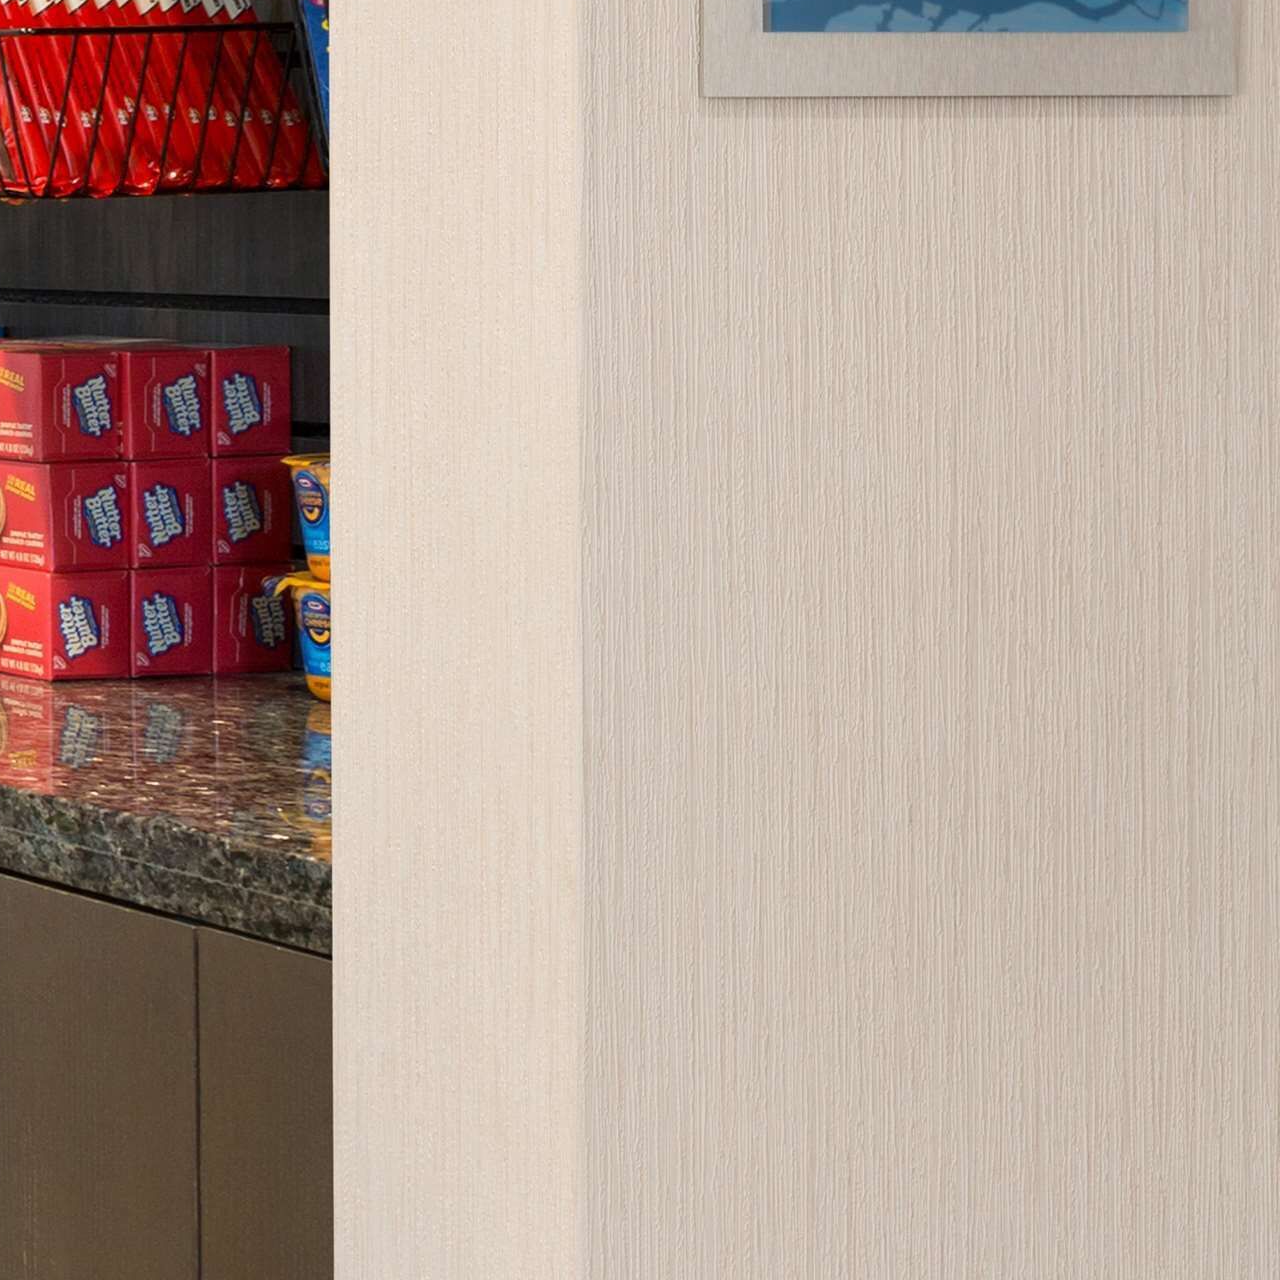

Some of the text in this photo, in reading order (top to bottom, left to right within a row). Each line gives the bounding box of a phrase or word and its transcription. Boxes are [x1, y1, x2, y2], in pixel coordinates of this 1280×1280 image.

[74, 385, 102, 436] Butter
[88, 376, 112, 429] Nutter
[164, 385, 190, 436] Butter
[177, 375, 201, 429] Nutter
[223, 380, 249, 435] Nutter
[234, 373, 261, 425] Butter
[85, 496, 112, 547] Butter
[97, 486, 122, 541] Nutter
[144, 491, 169, 547] Nutter
[155, 485, 183, 536] Butter
[223, 487, 248, 543] Nutter
[235, 481, 261, 532] Butter
[59, 603, 85, 659] Nutter
[71, 596, 99, 649] Butter
[142, 599, 168, 656] Nutter
[154, 593, 181, 645] Butter
